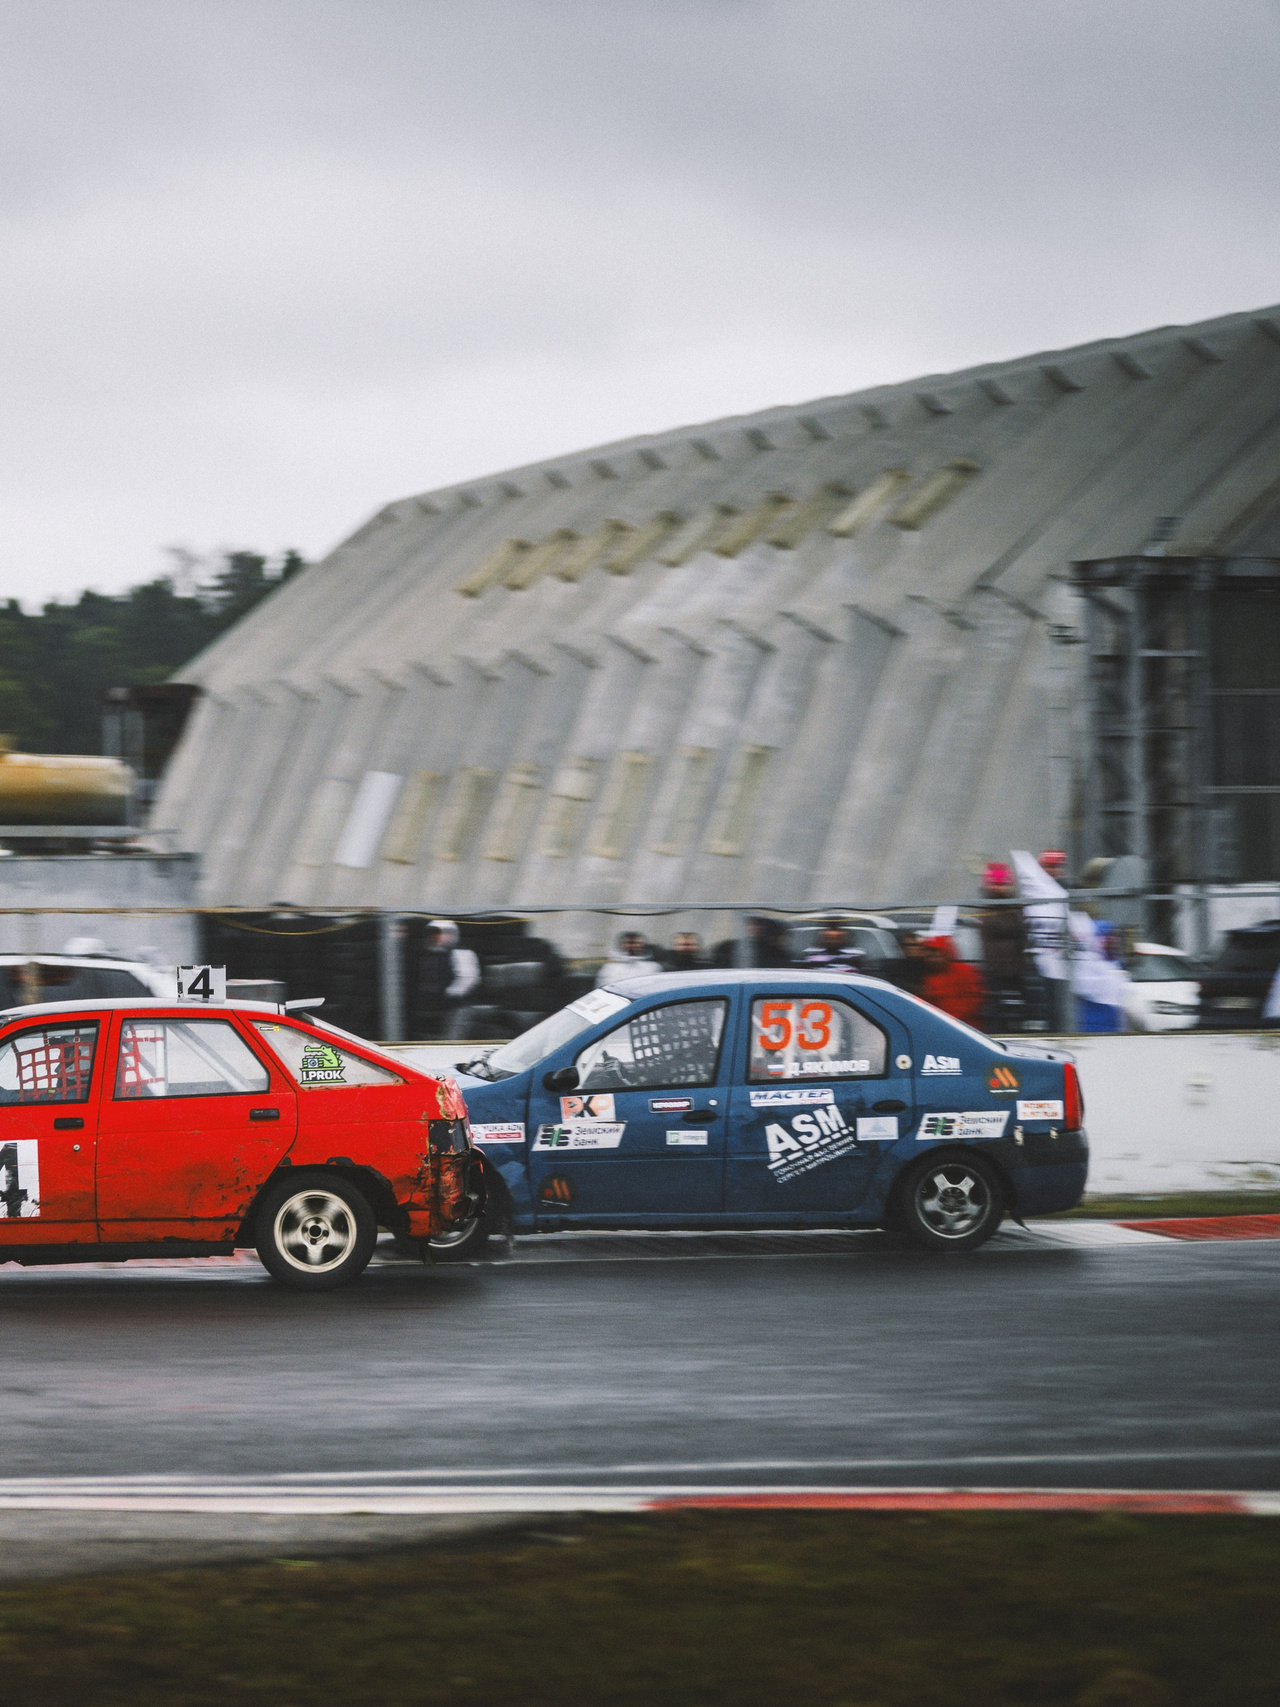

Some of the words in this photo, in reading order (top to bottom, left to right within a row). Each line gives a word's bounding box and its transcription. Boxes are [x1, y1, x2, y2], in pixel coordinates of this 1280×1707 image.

[187, 967, 214, 999] 4
[758, 1002, 833, 1050] 53
[302, 1070, 342, 1081] I.PROK
[923, 1054, 961, 1069] ASM
[765, 1105, 846, 1161] ASM
